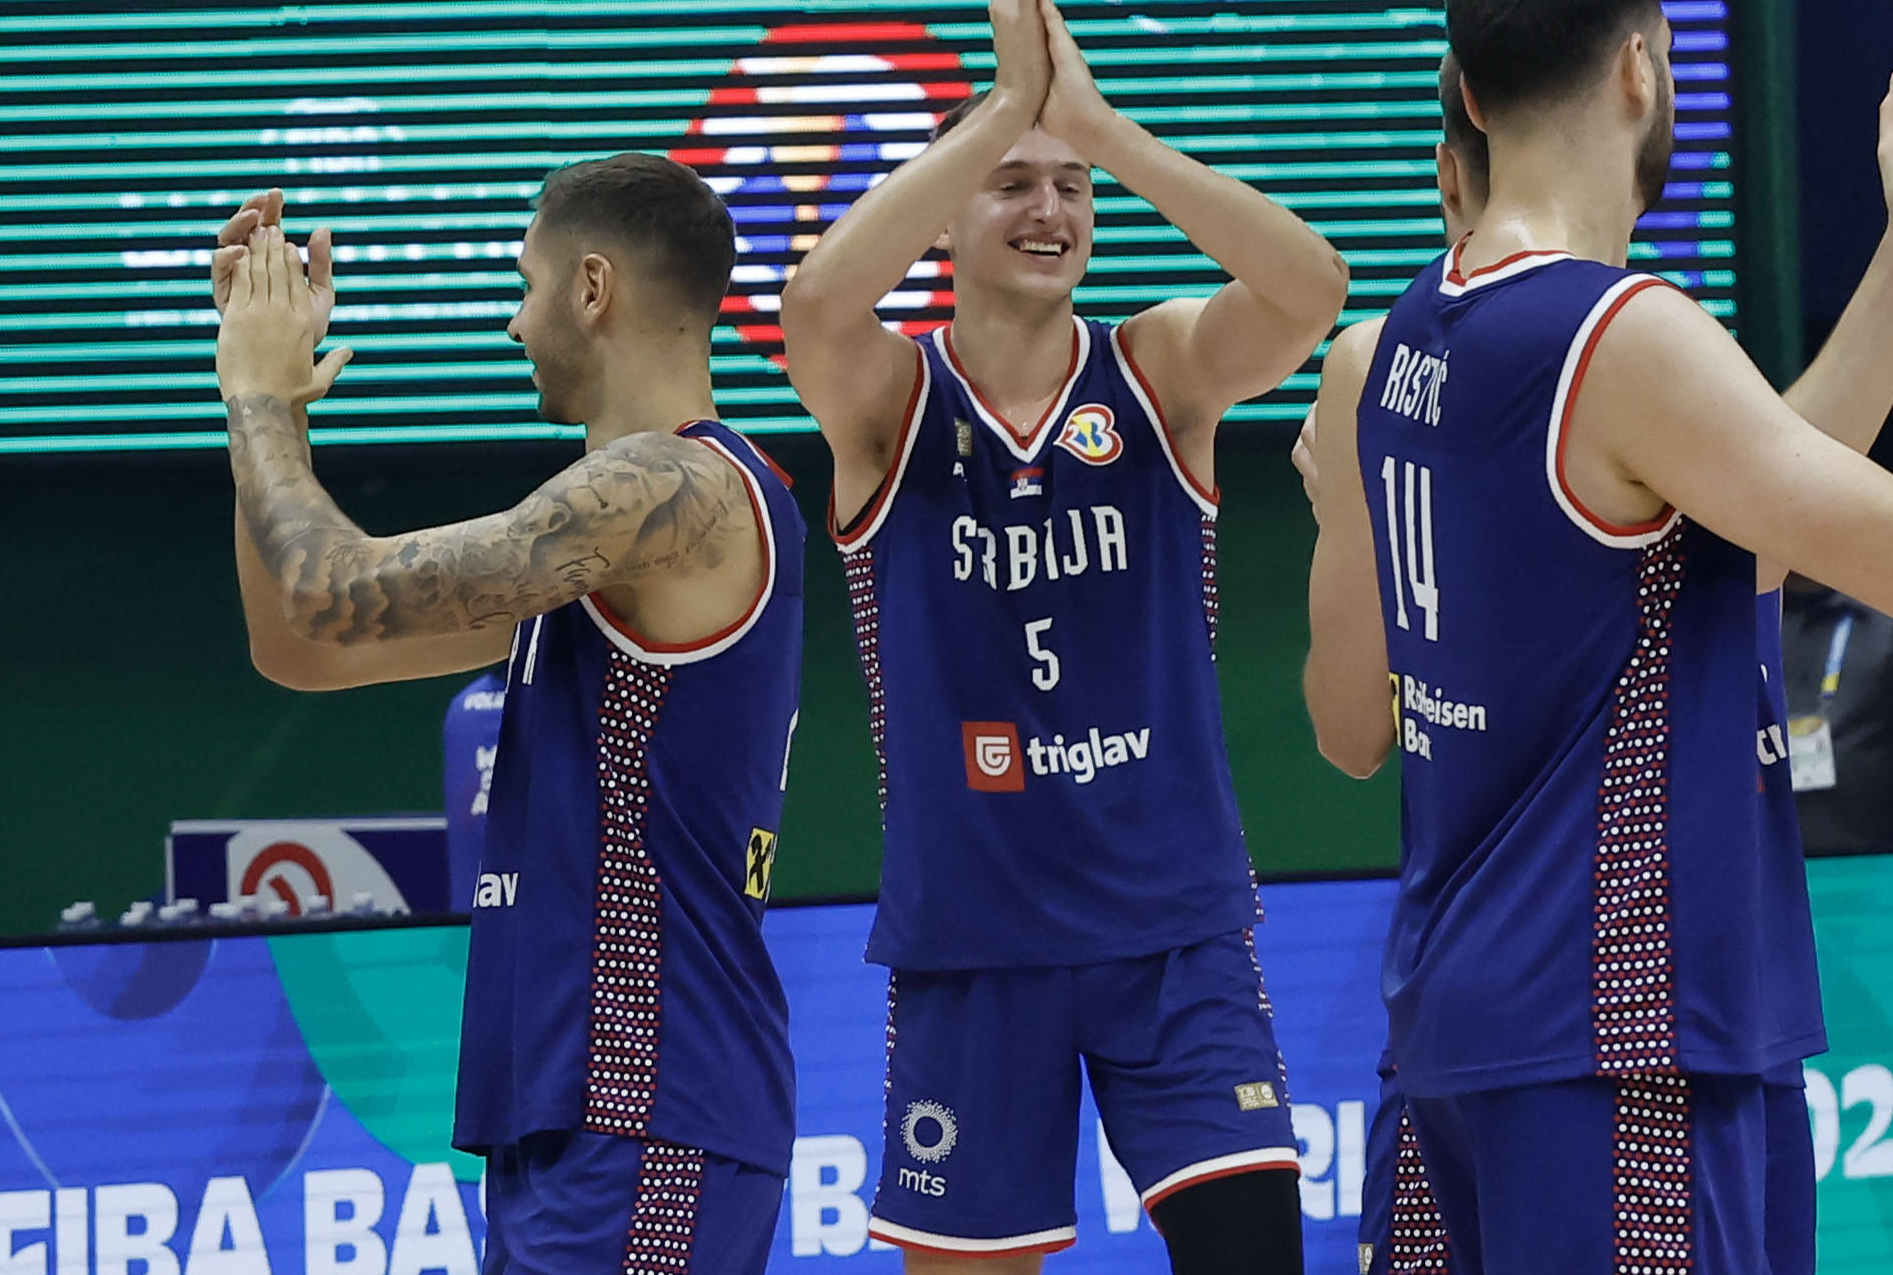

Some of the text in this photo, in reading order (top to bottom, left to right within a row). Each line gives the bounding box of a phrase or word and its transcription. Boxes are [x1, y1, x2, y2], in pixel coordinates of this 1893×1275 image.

[951, 504, 1129, 592] SRBIJA
[1381, 455, 1440, 643] 14
[1024, 617, 1061, 692] 5
[1027, 725, 1152, 786] triglav
[898, 1167, 947, 1197] mts
